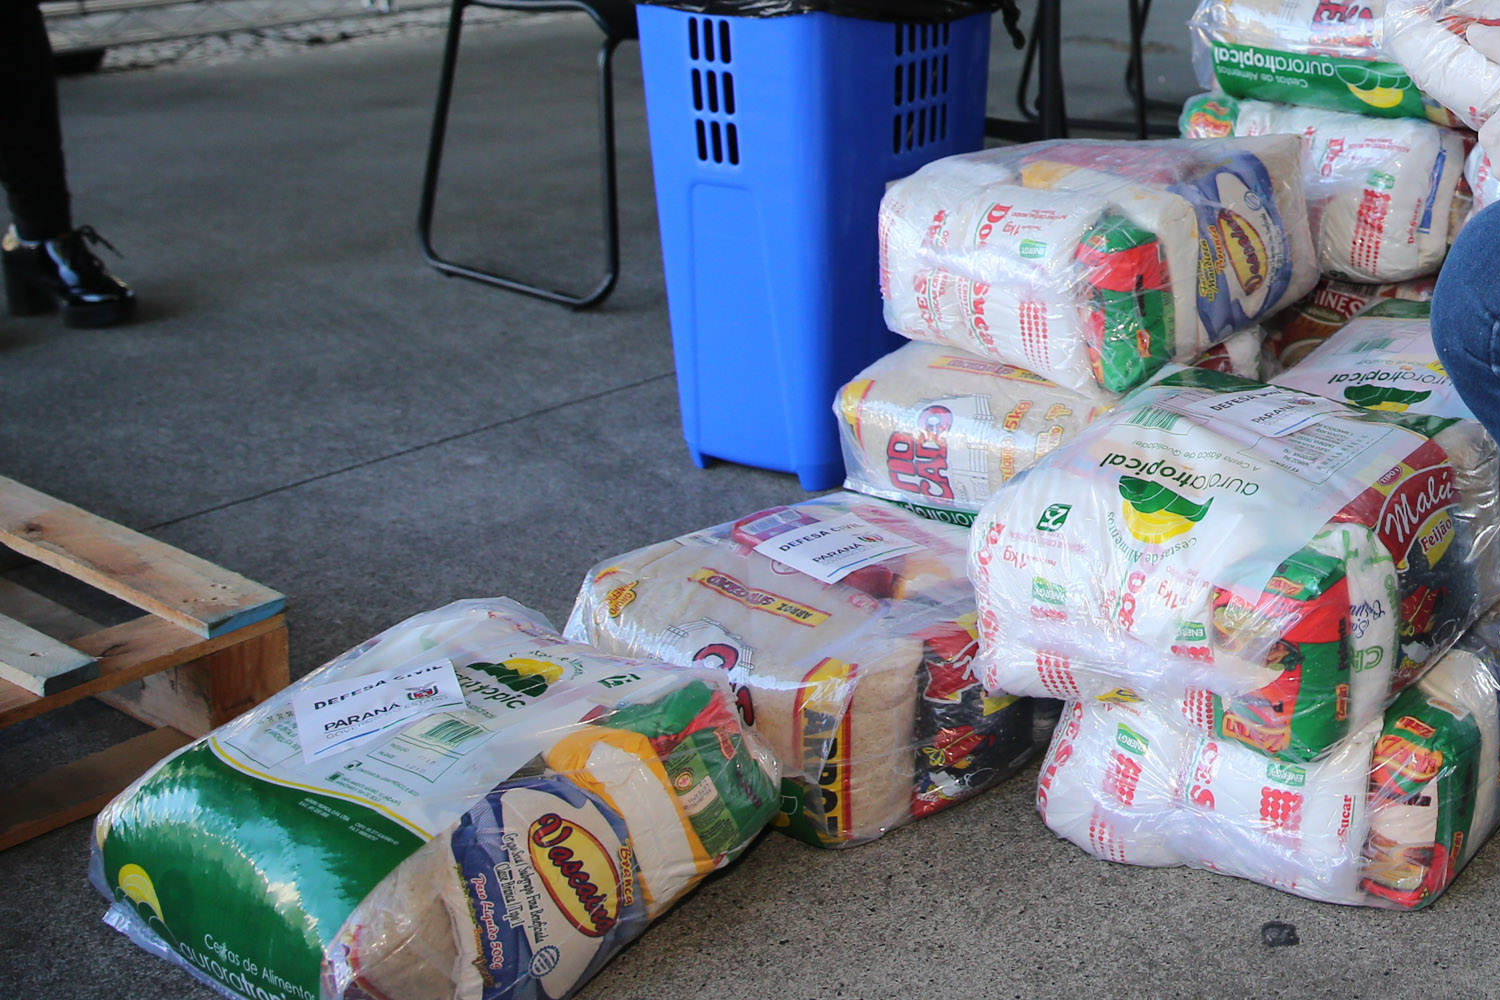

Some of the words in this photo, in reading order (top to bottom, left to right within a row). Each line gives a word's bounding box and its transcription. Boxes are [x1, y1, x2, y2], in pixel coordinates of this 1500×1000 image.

[1213, 46, 1336, 78] auroratropical
[1275, 75, 1309, 89] Cestas
[1004, 400, 1032, 432] 5kg
[1210, 394, 1259, 412] DEFESA
[1099, 452, 1260, 496] auroratropical
[1380, 469, 1396, 484] TIPO
[779, 529, 830, 552] DEFESA
[1107, 511, 1143, 564] Alimentos
[1159, 536, 1198, 562] Cestas
[1420, 517, 1453, 553] Feijão
[811, 541, 864, 564] PARANÁ
[1144, 550, 1160, 566] de
[775, 602, 813, 620] ARROZ
[314, 679, 387, 711] DEFESA
[324, 701, 402, 732] PARANÁ
[471, 872, 487, 900] Peso
[618, 838, 636, 908] Branca
[480, 900, 499, 941] Líquido
[243, 957, 258, 976] de
[489, 941, 503, 970] 500g
